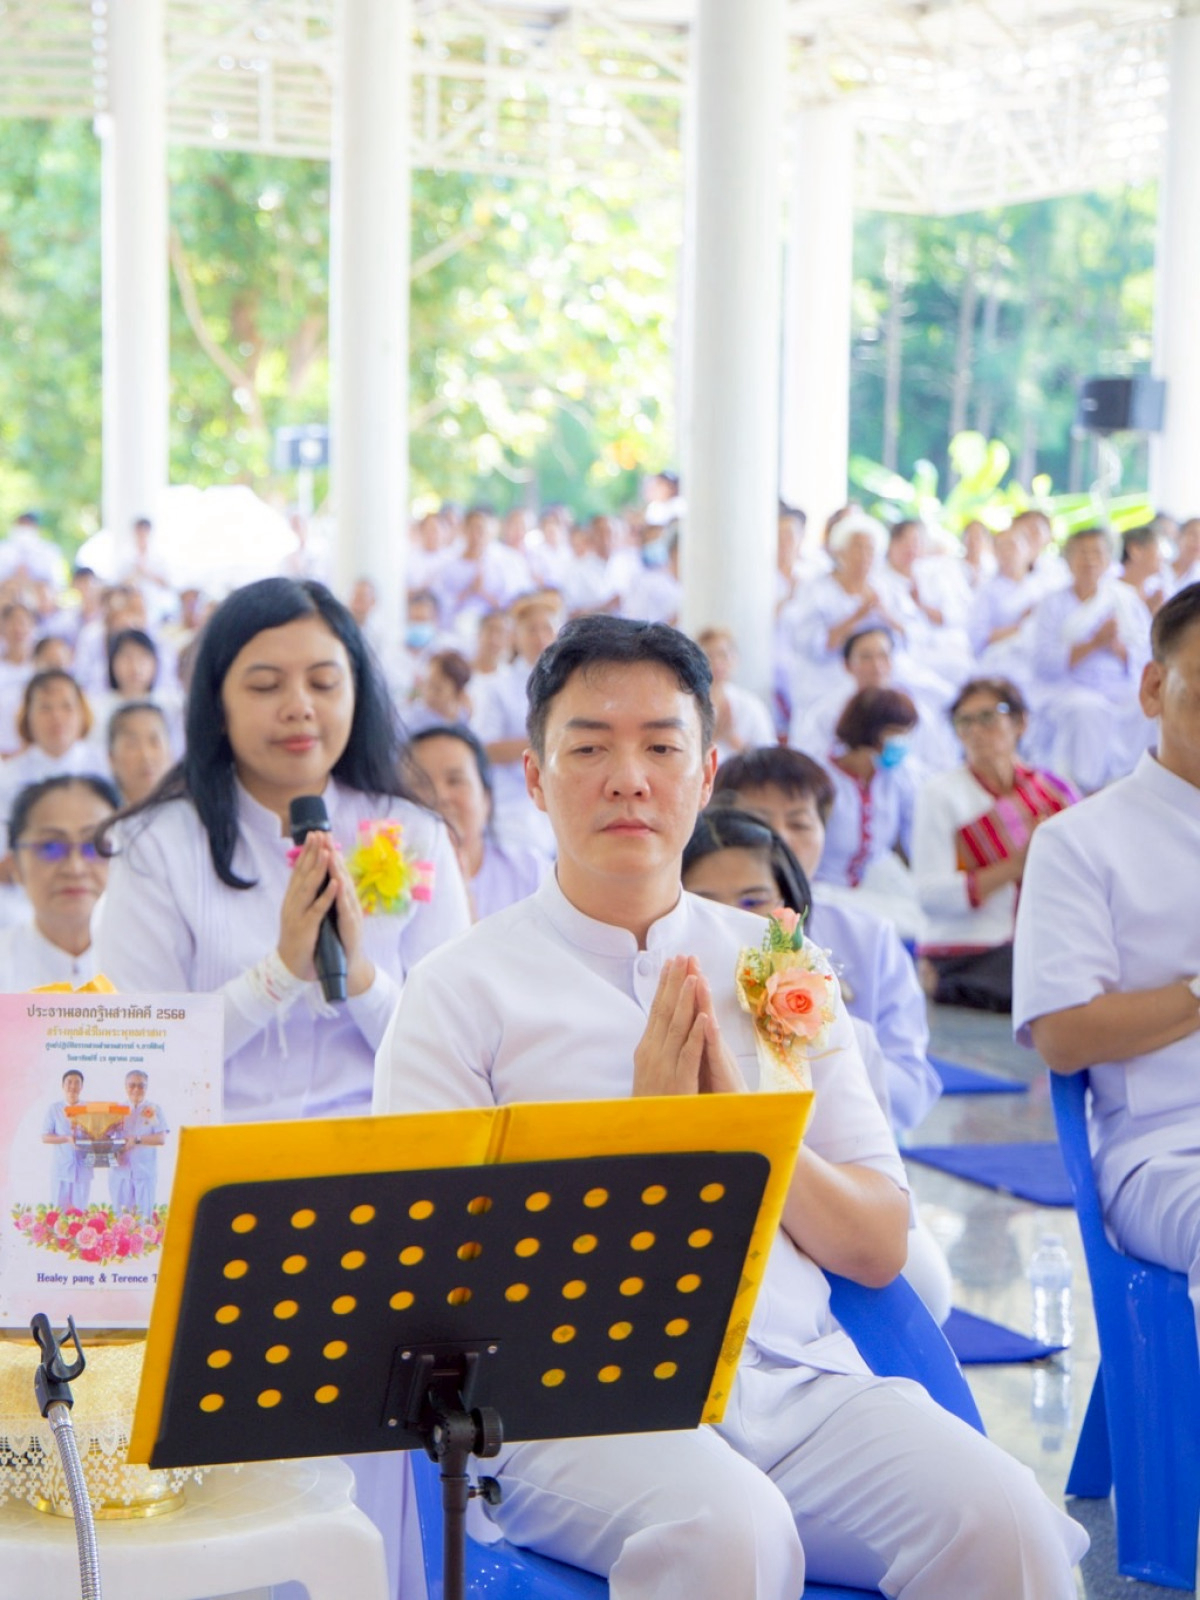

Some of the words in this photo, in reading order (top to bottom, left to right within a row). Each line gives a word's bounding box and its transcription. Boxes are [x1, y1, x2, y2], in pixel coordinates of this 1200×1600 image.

[156, 1008, 186, 1020] 2568
[36, 1272, 68, 1285] Healey
[72, 1275, 95, 1285] pang
[98, 1272, 107, 1283] &
[111, 1273, 149, 1283] Terence
